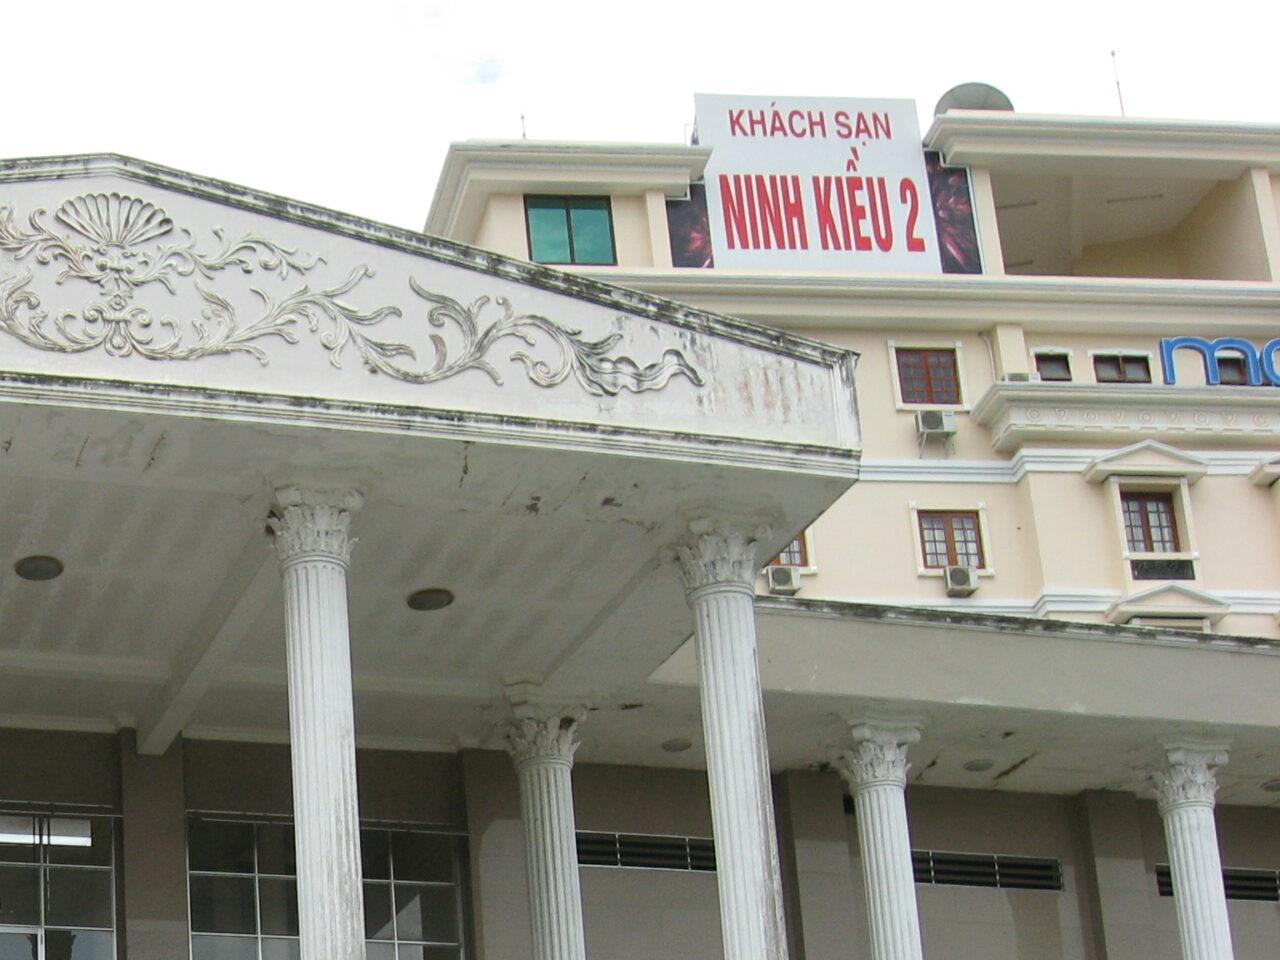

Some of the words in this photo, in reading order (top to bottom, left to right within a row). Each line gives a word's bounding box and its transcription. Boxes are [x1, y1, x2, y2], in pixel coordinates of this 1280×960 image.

[728, 101, 827, 138] KHÁCH
[834, 111, 892, 147] SẠN
[718, 173, 809, 250] NINH
[811, 146, 894, 252] KIỀU
[899, 177, 926, 252] 2
